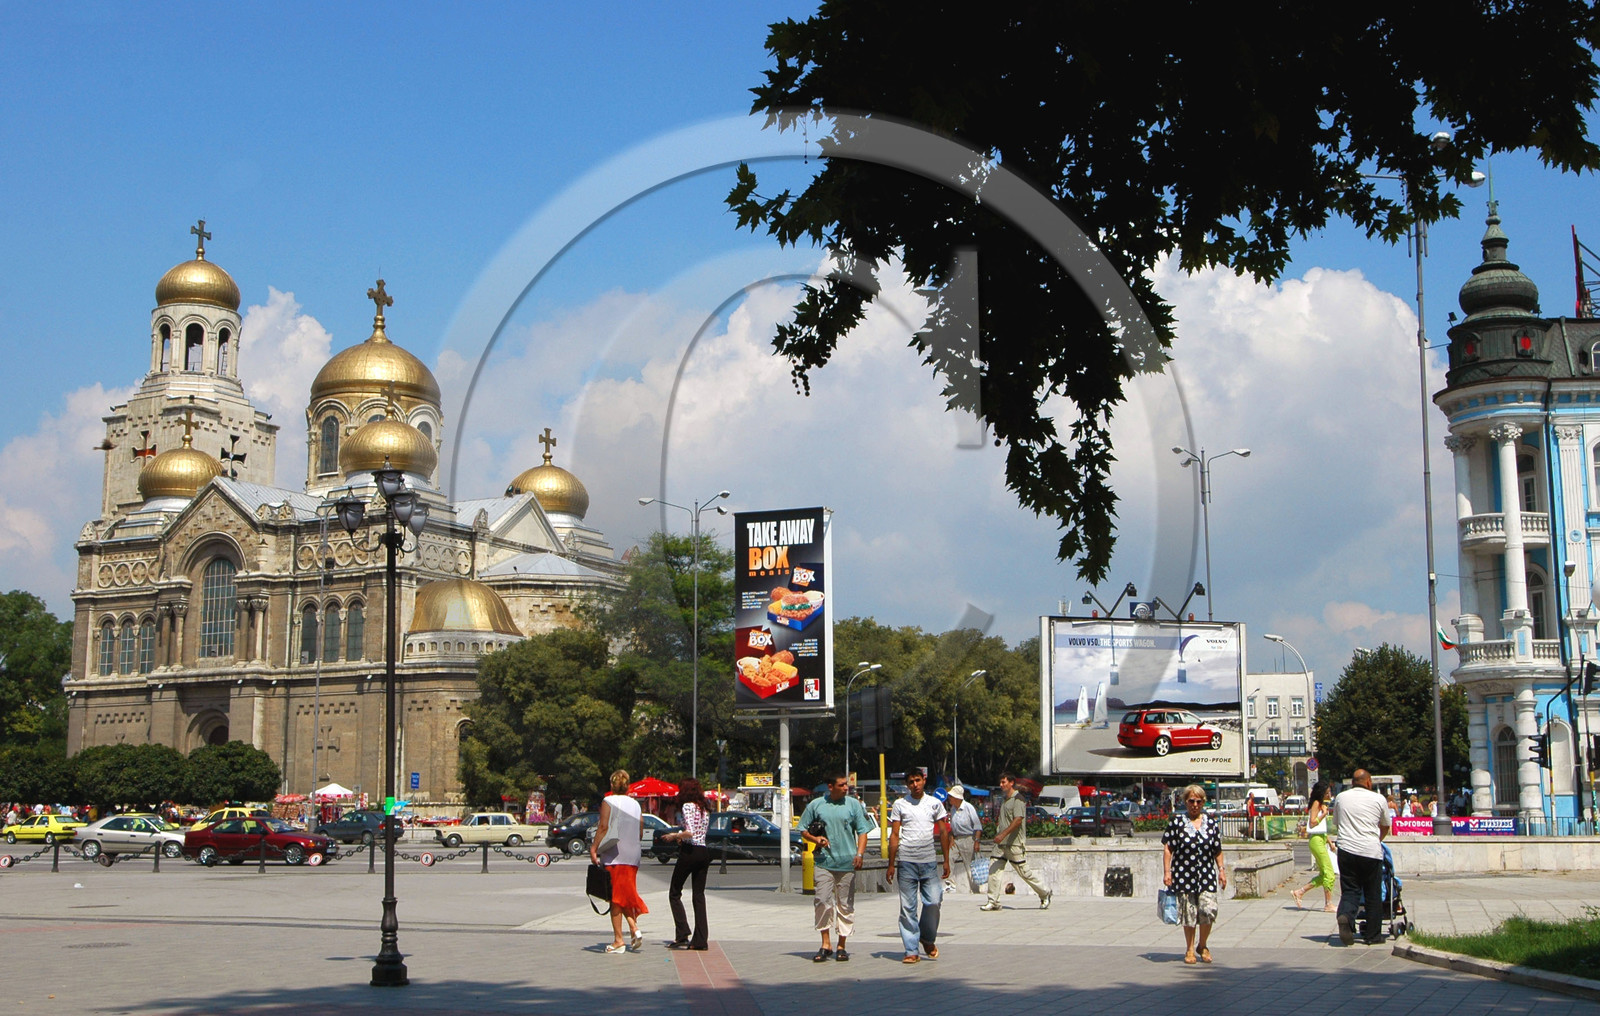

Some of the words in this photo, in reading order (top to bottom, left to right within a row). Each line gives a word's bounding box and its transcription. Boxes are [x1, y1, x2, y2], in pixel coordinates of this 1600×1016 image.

[746, 521, 778, 548] TAKE
[779, 518, 815, 546] AWAY
[748, 546, 790, 570] BOX
[792, 570, 816, 583] BOX
[749, 633, 773, 647] BOX
[1068, 637, 1086, 646] VOLVO
[1100, 637, 1111, 647] THE
